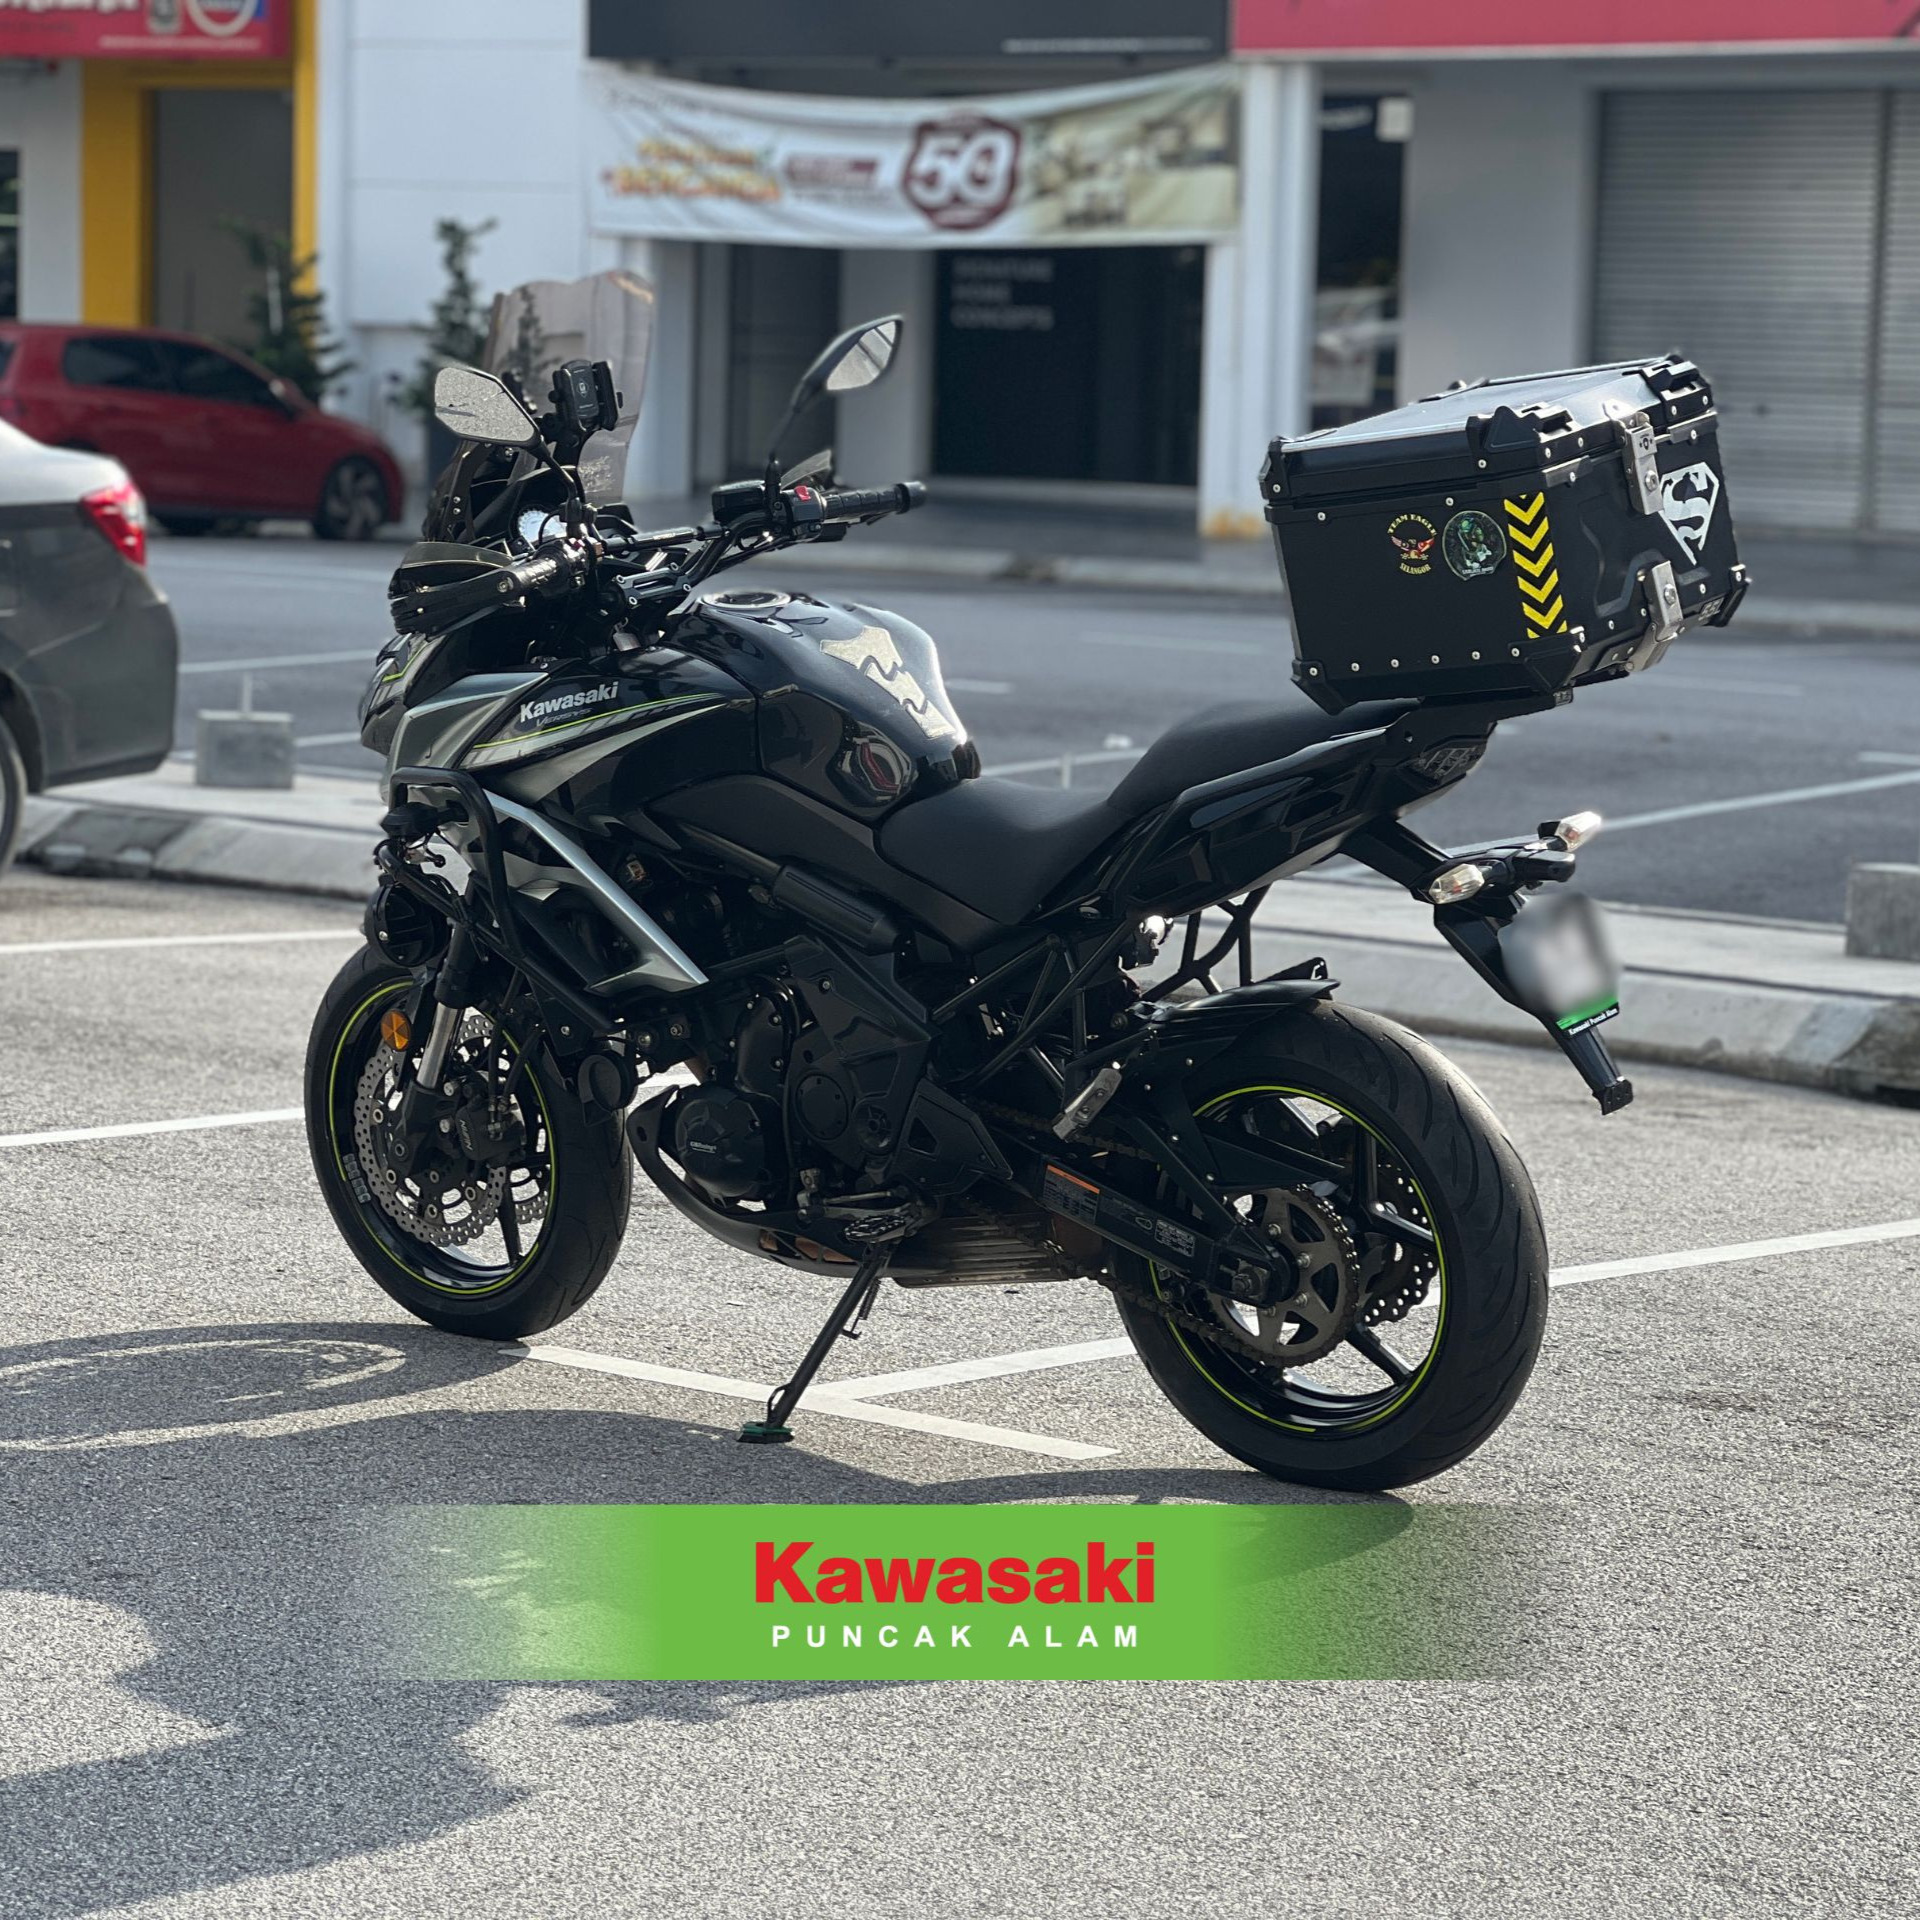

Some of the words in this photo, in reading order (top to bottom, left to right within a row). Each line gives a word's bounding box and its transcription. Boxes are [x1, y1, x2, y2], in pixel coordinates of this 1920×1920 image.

[1386, 514, 1408, 534] TEAM
[1410, 513, 1437, 536] EAGLE
[1399, 562, 1431, 574] SELANGOR
[520, 681, 619, 723] Kawasaki
